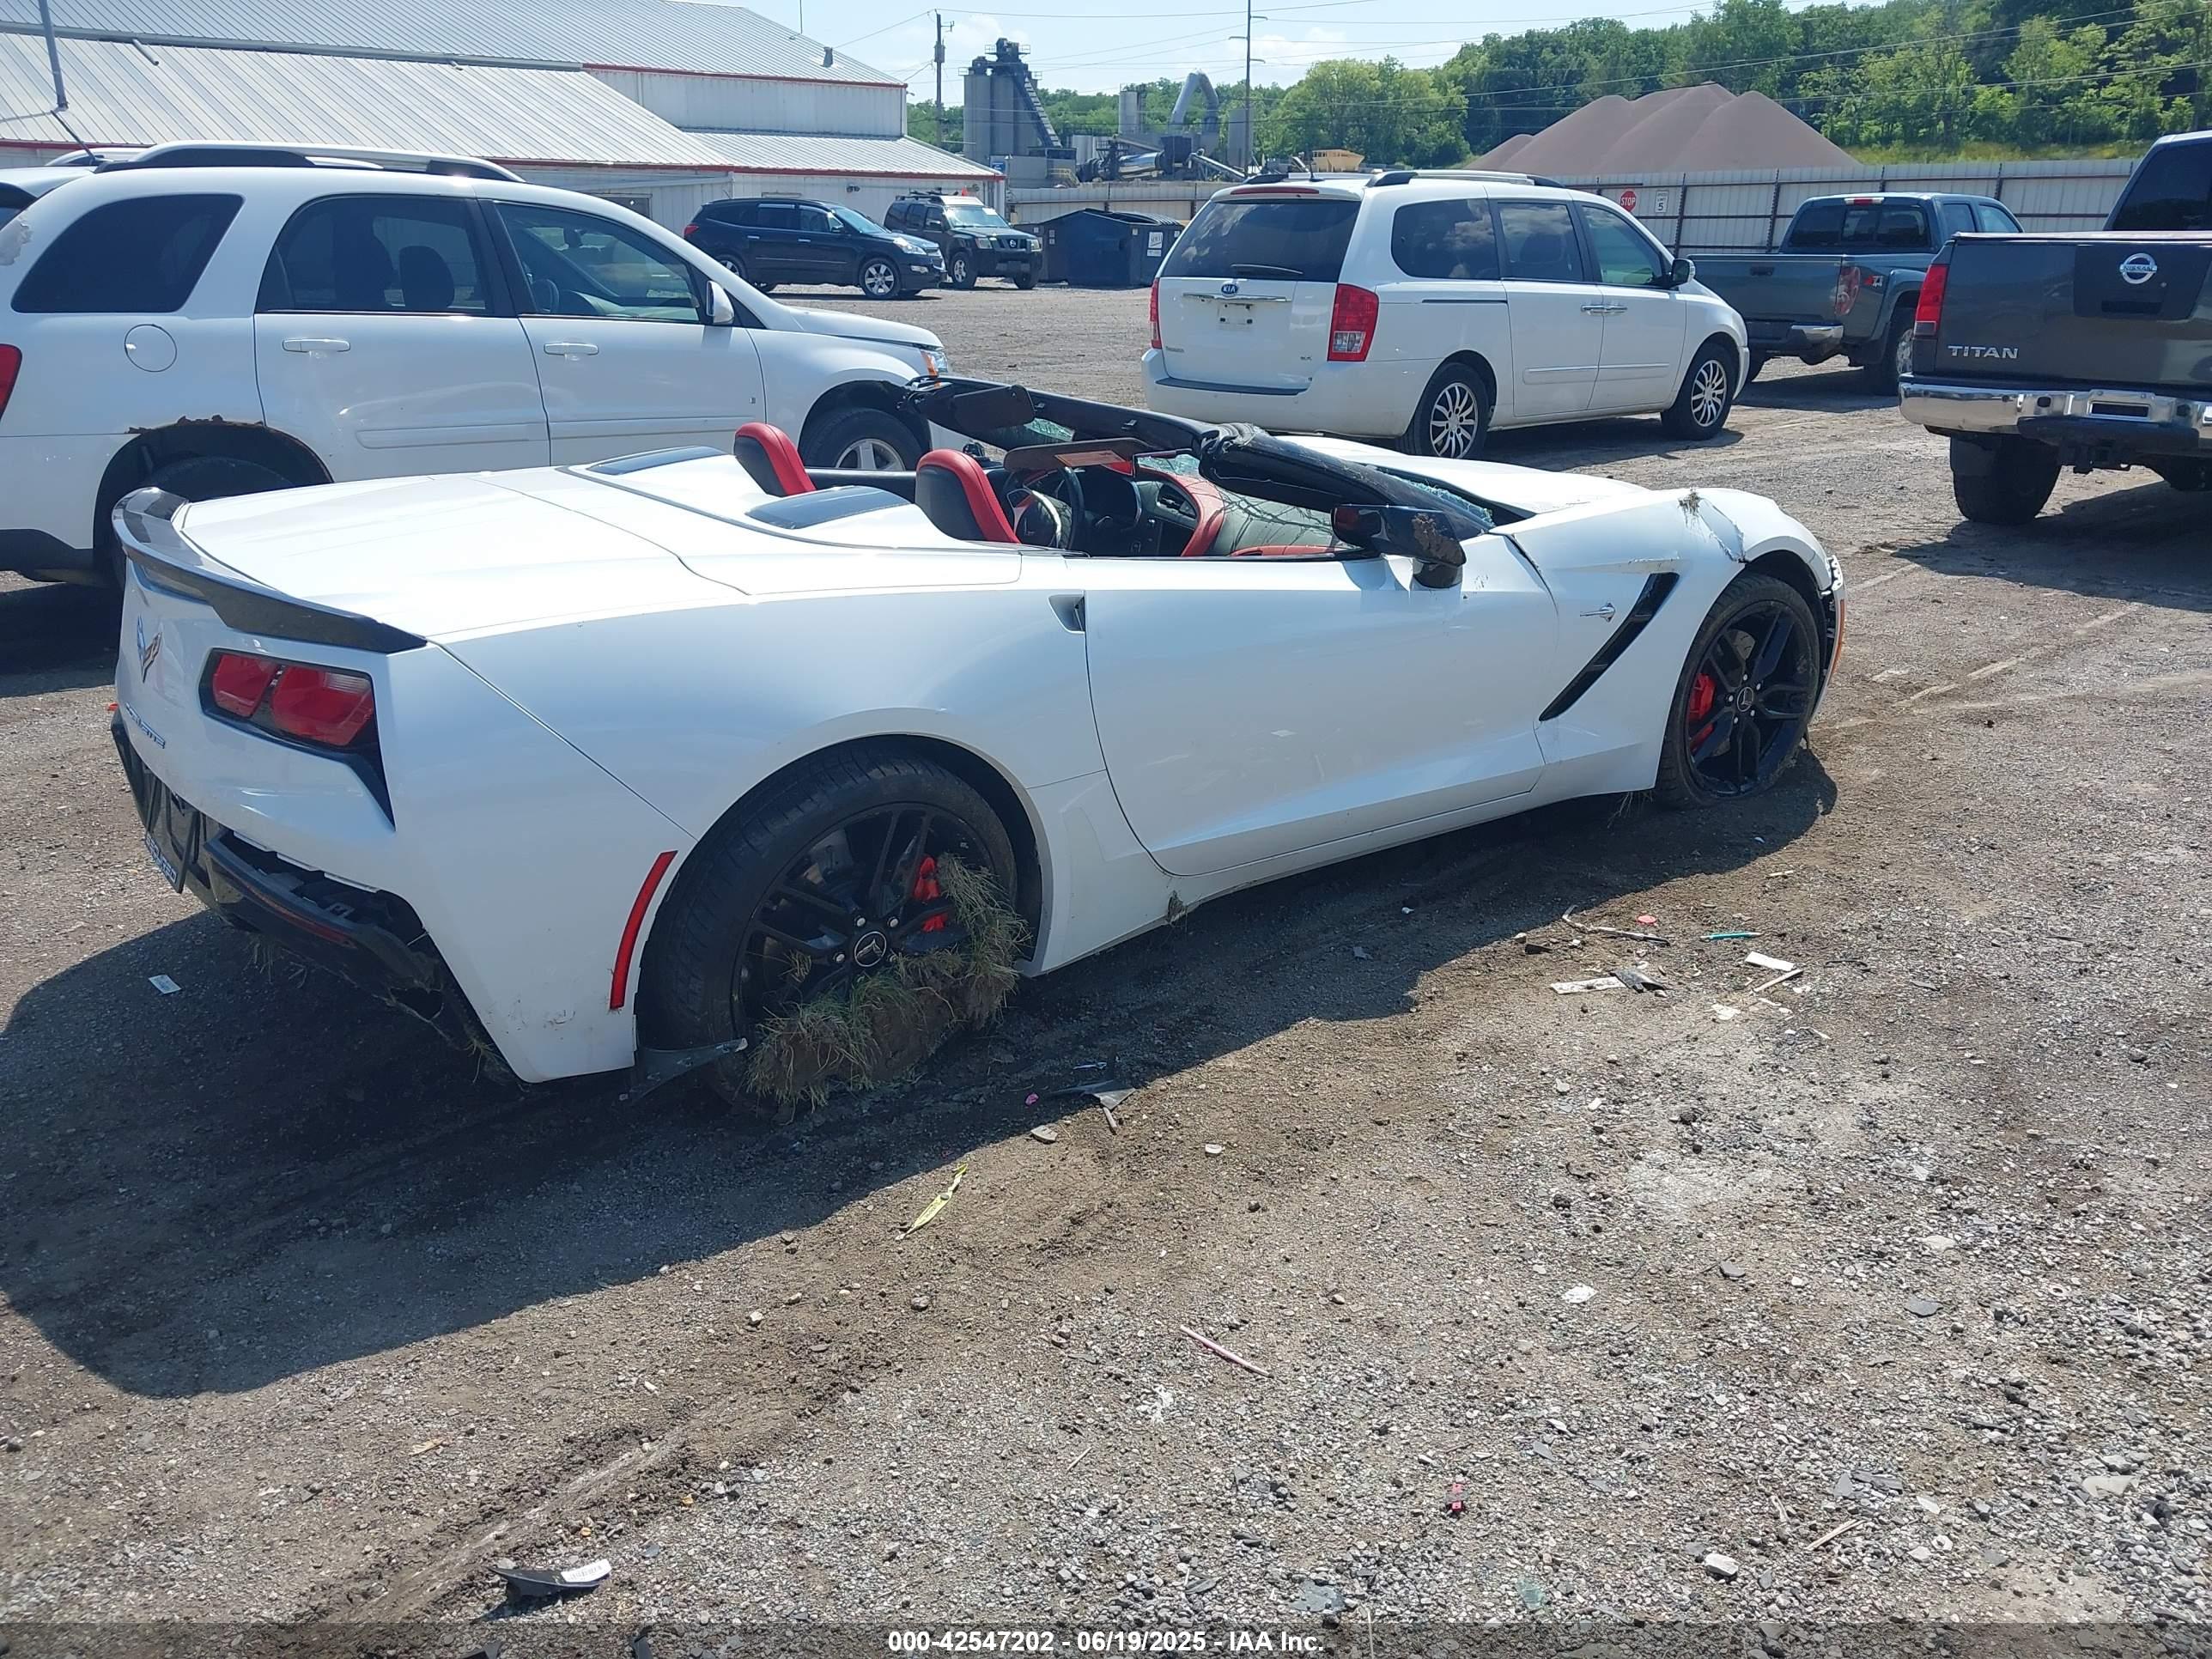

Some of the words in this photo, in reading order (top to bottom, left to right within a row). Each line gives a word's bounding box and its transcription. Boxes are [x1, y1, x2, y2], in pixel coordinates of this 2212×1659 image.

[1620, 197, 1636, 206] STOP
[1657, 202, 1664, 211] 5
[1948, 345, 2019, 359] TITAN
